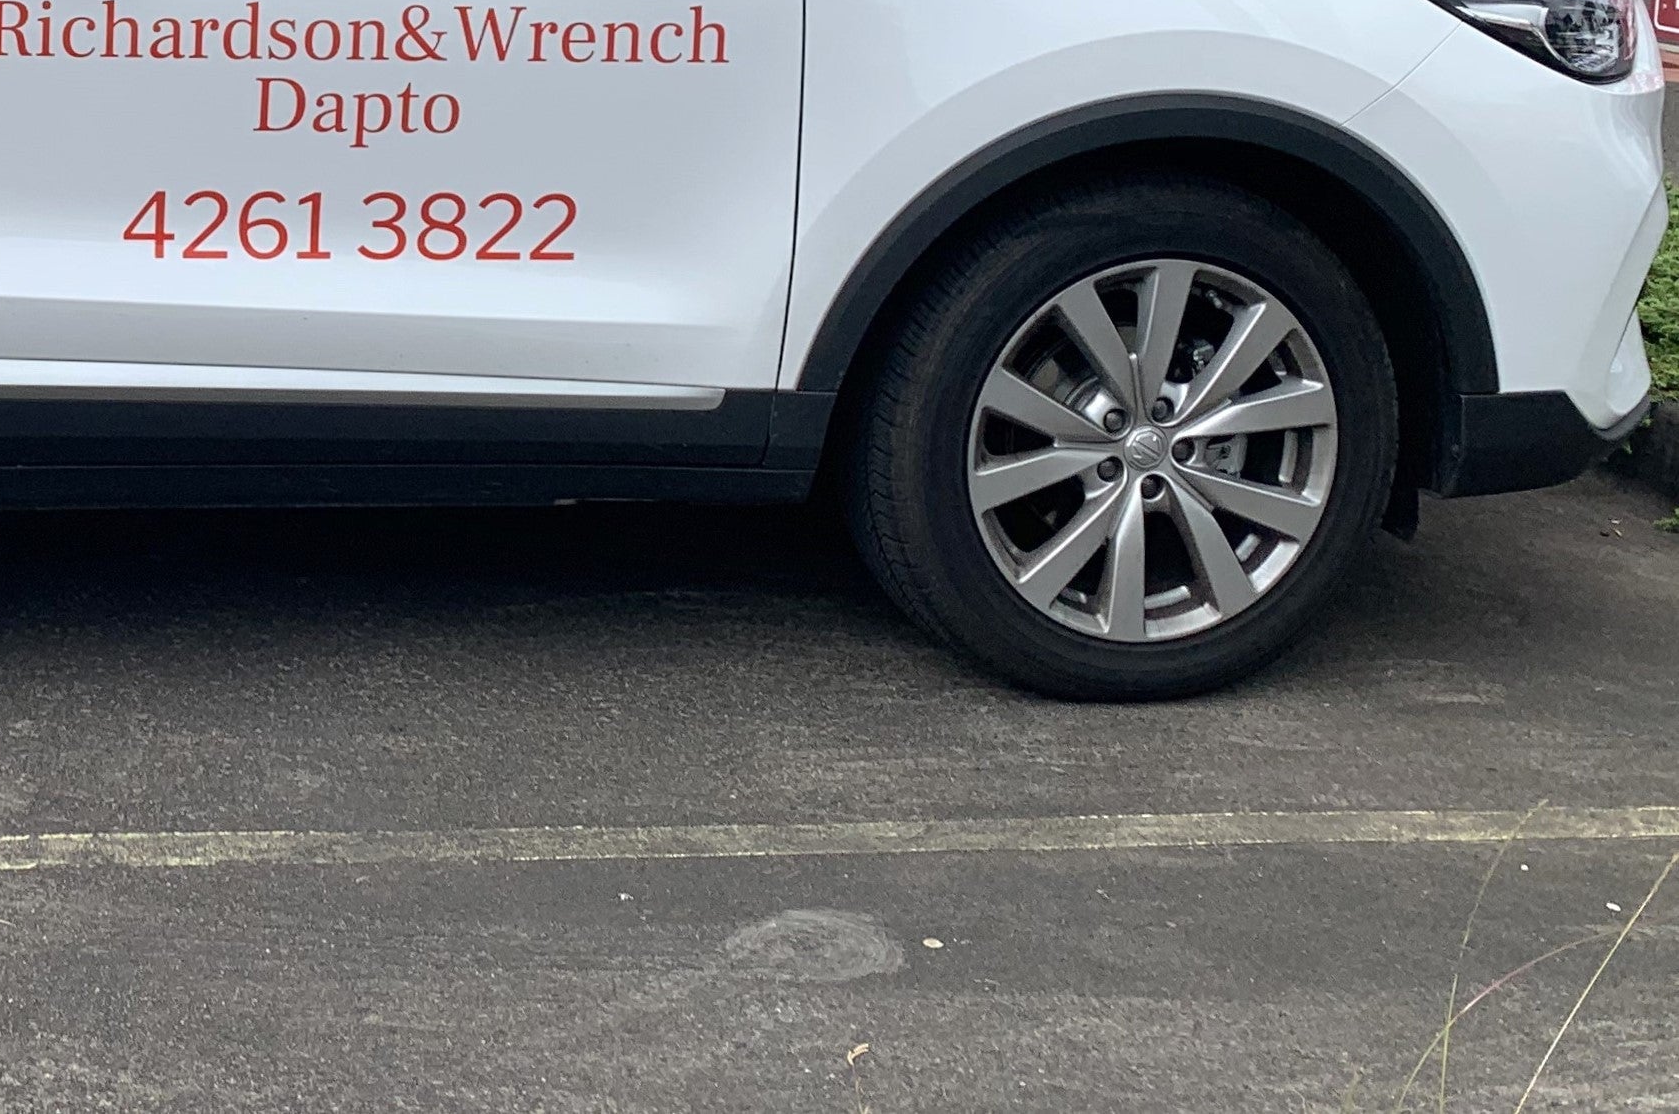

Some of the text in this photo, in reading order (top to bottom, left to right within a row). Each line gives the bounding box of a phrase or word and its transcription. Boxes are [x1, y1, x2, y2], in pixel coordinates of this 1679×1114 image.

[252, 77, 461, 148] Dapto
[122, 189, 578, 262] 4261 3822
